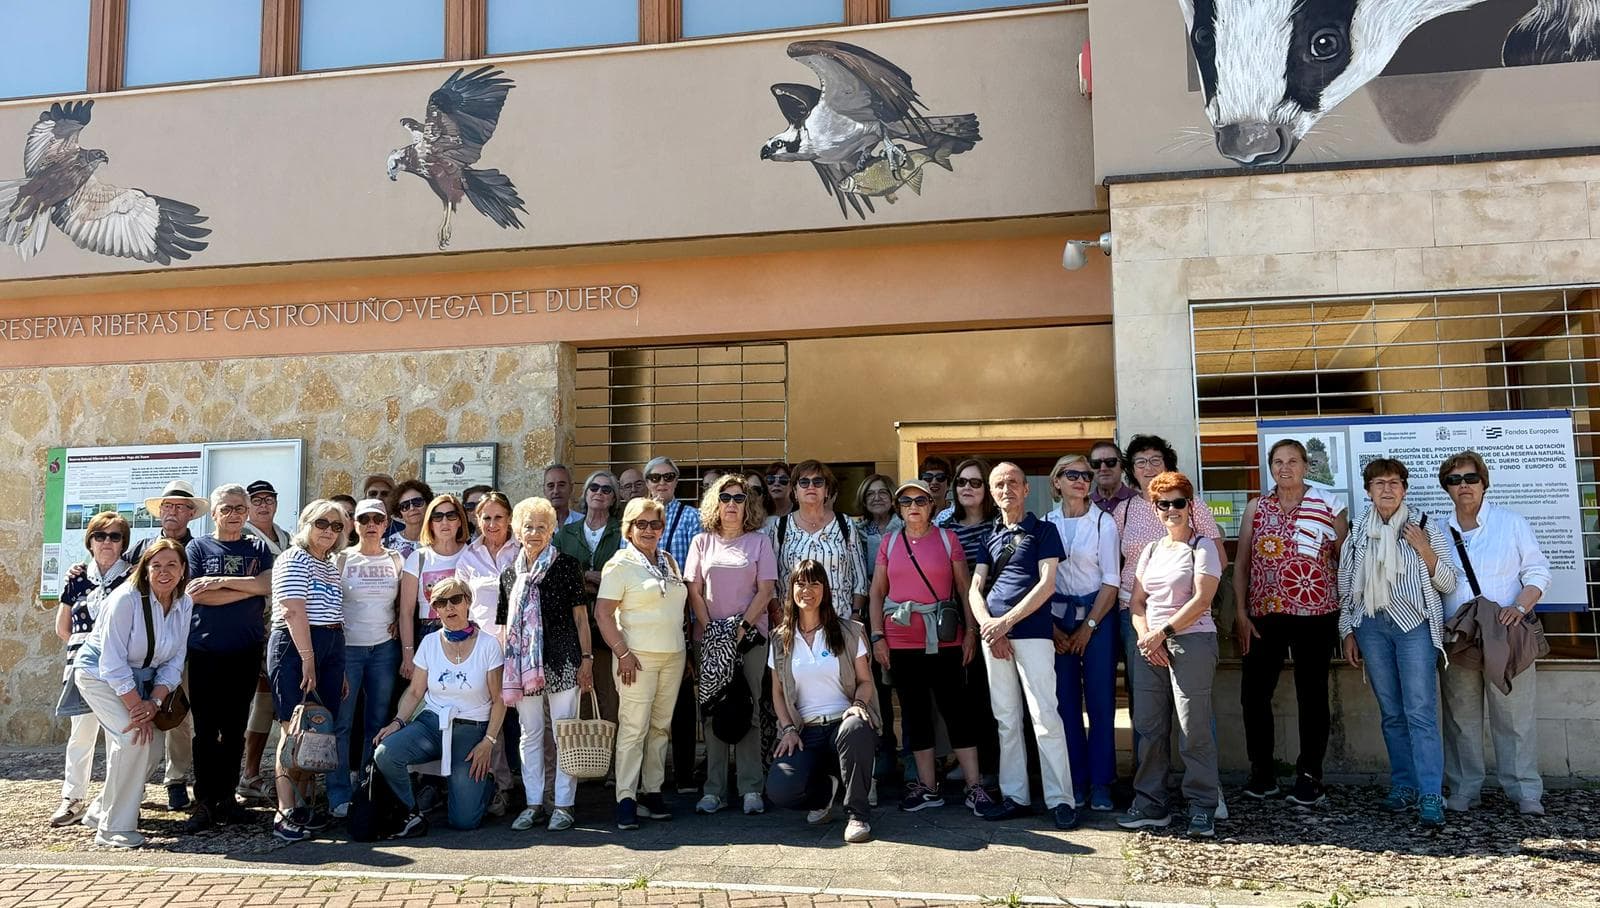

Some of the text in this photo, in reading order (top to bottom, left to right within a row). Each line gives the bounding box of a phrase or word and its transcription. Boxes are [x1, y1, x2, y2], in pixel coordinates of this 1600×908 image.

[0, 316, 85, 340] RESERVA
[92, 311, 178, 337] RIBERAS
[185, 310, 214, 332] DE
[492, 290, 536, 316] DEL
[546, 285, 638, 312] DUERO
[347, 566, 395, 578] PARIS
